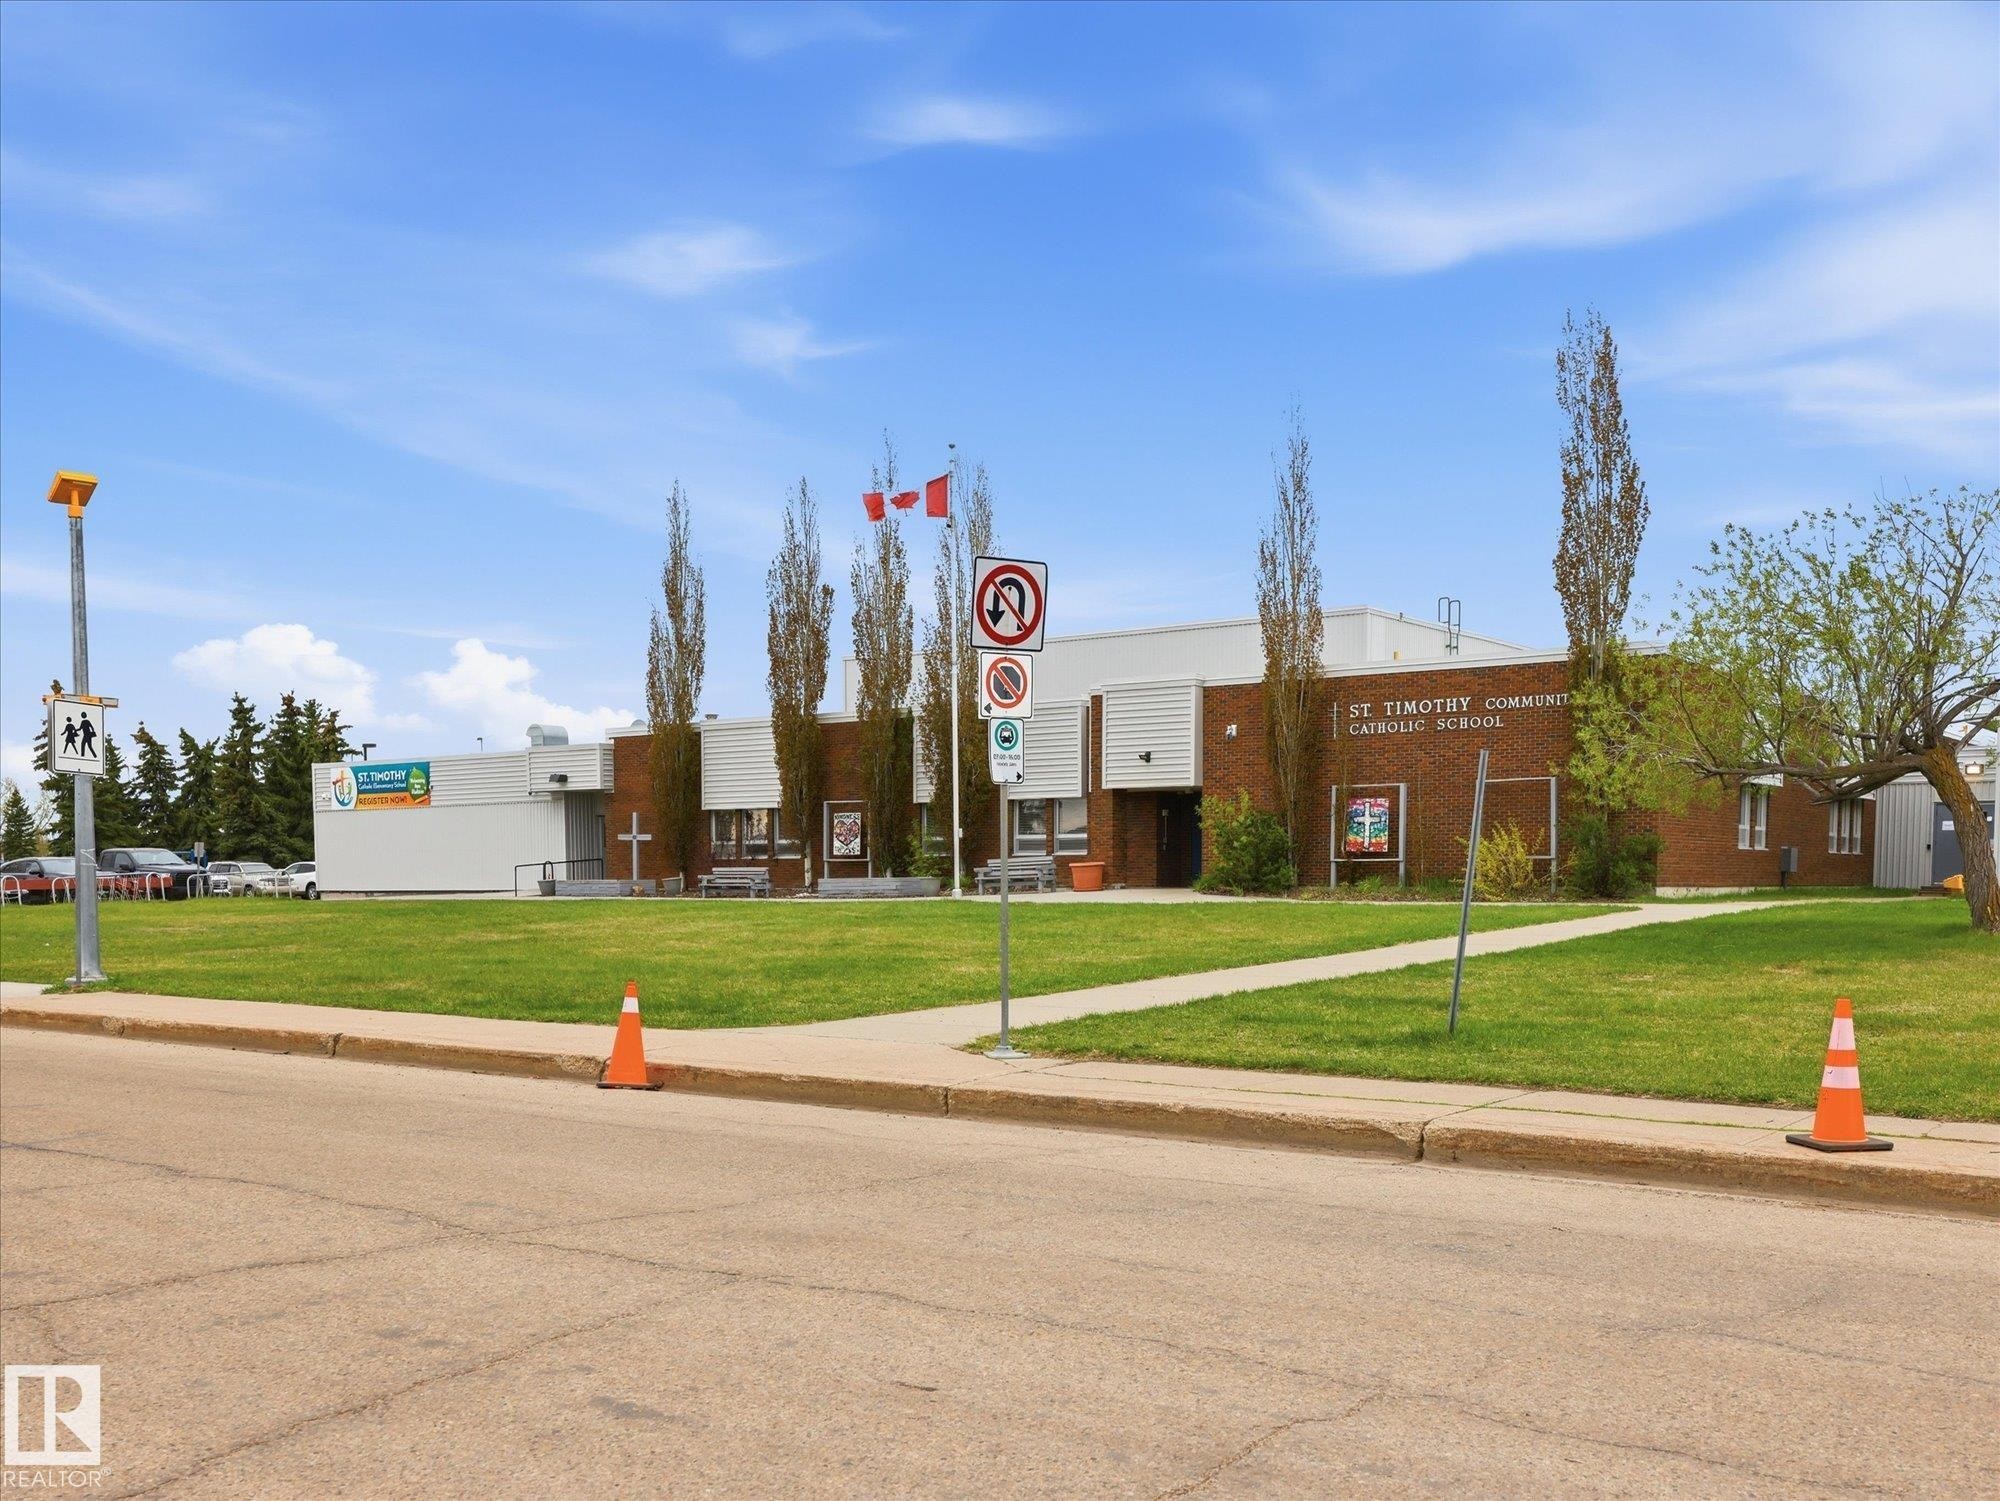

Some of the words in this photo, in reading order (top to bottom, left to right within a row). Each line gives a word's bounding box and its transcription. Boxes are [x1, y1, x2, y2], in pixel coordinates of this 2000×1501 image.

[1349, 703, 1372, 718] ST.
[1383, 697, 1471, 716] TIMOTHY
[1485, 693, 1570, 710] COMMUNIT
[1349, 719, 1425, 735] CATHOLIC
[1437, 716, 1504, 730] SCHOOL
[358, 772, 370, 782] ST.
[370, 770, 407, 781] TIMOTHY
[359, 796, 389, 805] REGISTER
[390, 795, 408, 804] NOW!
